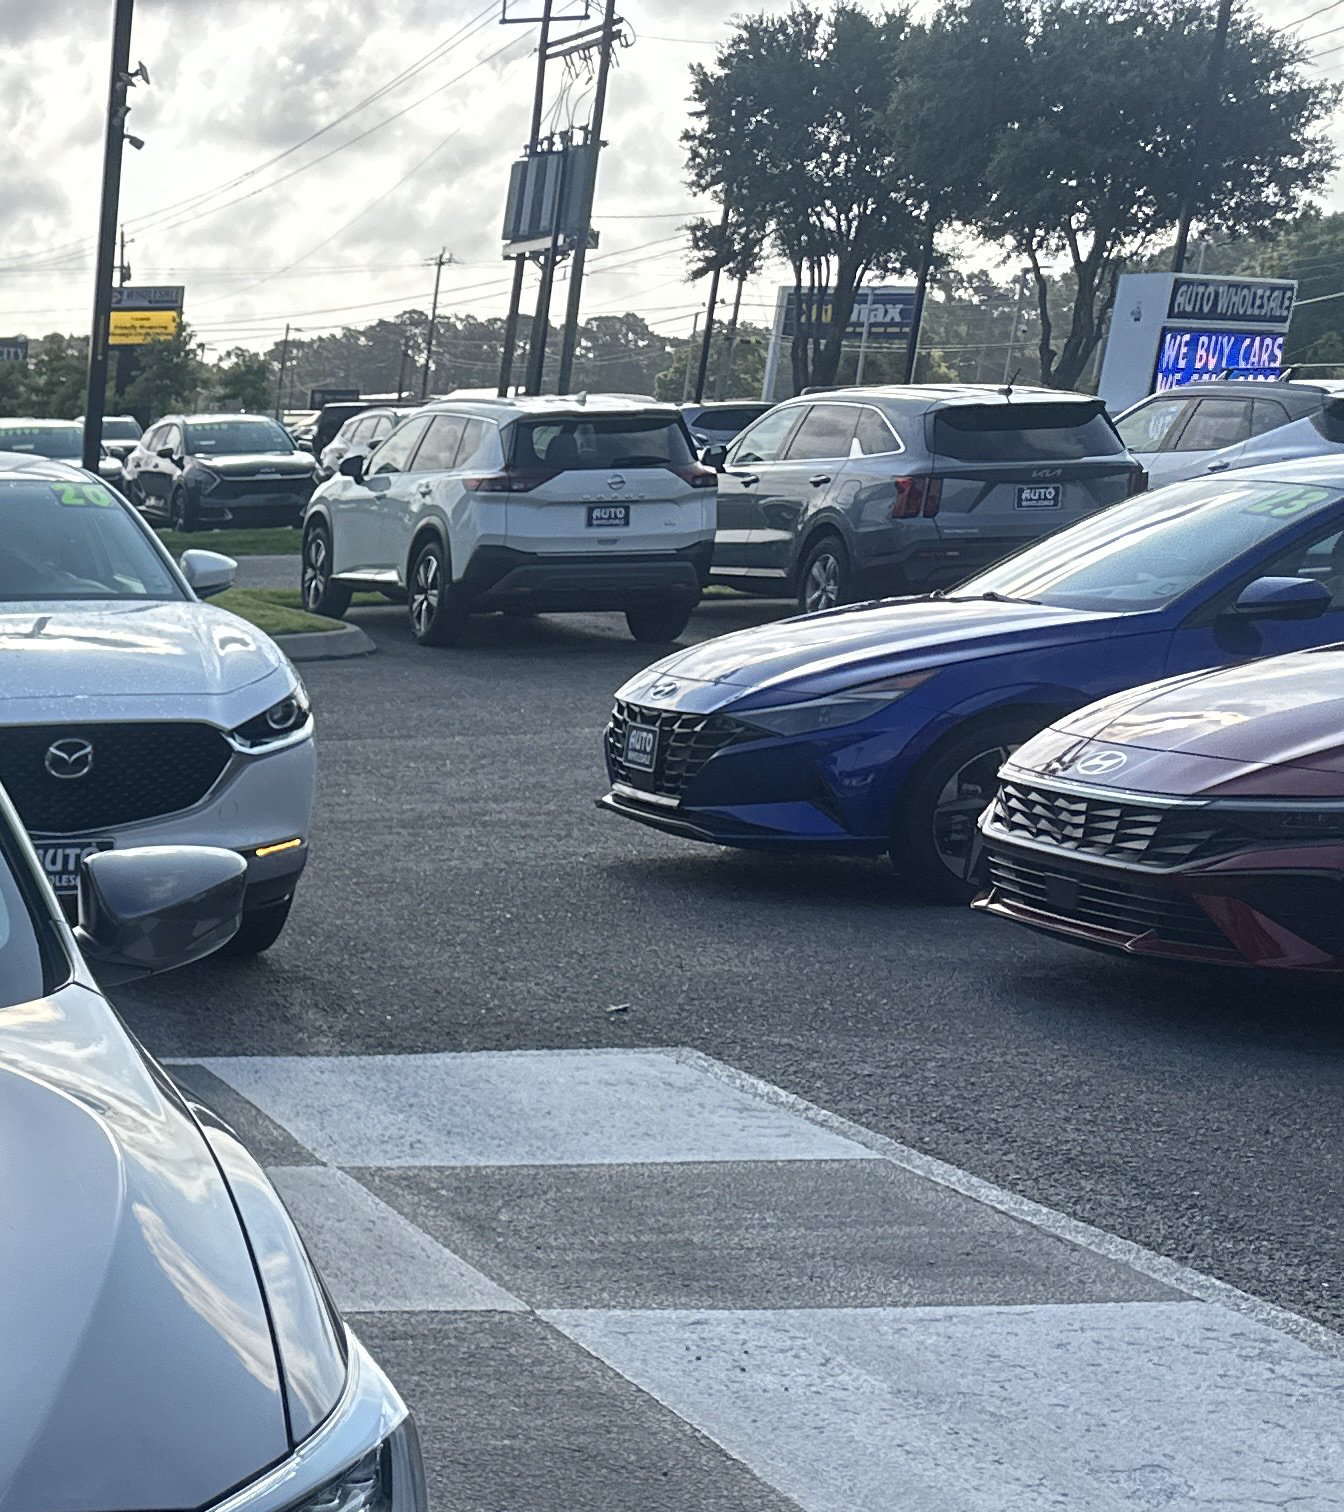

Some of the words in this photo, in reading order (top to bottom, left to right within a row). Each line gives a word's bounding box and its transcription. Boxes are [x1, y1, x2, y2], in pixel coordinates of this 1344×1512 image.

[1174, 284, 1215, 314] AUTO
[1217, 285, 1293, 319] WHOLESALE
[1162, 333, 1191, 370] WE
[1195, 335, 1234, 370] BUY
[1238, 336, 1283, 368] CARS
[49, 482, 113, 508] 20
[1021, 487, 1055, 501] AUTO
[592, 507, 625, 520] AUTO
[628, 729, 654, 753] AUTO
